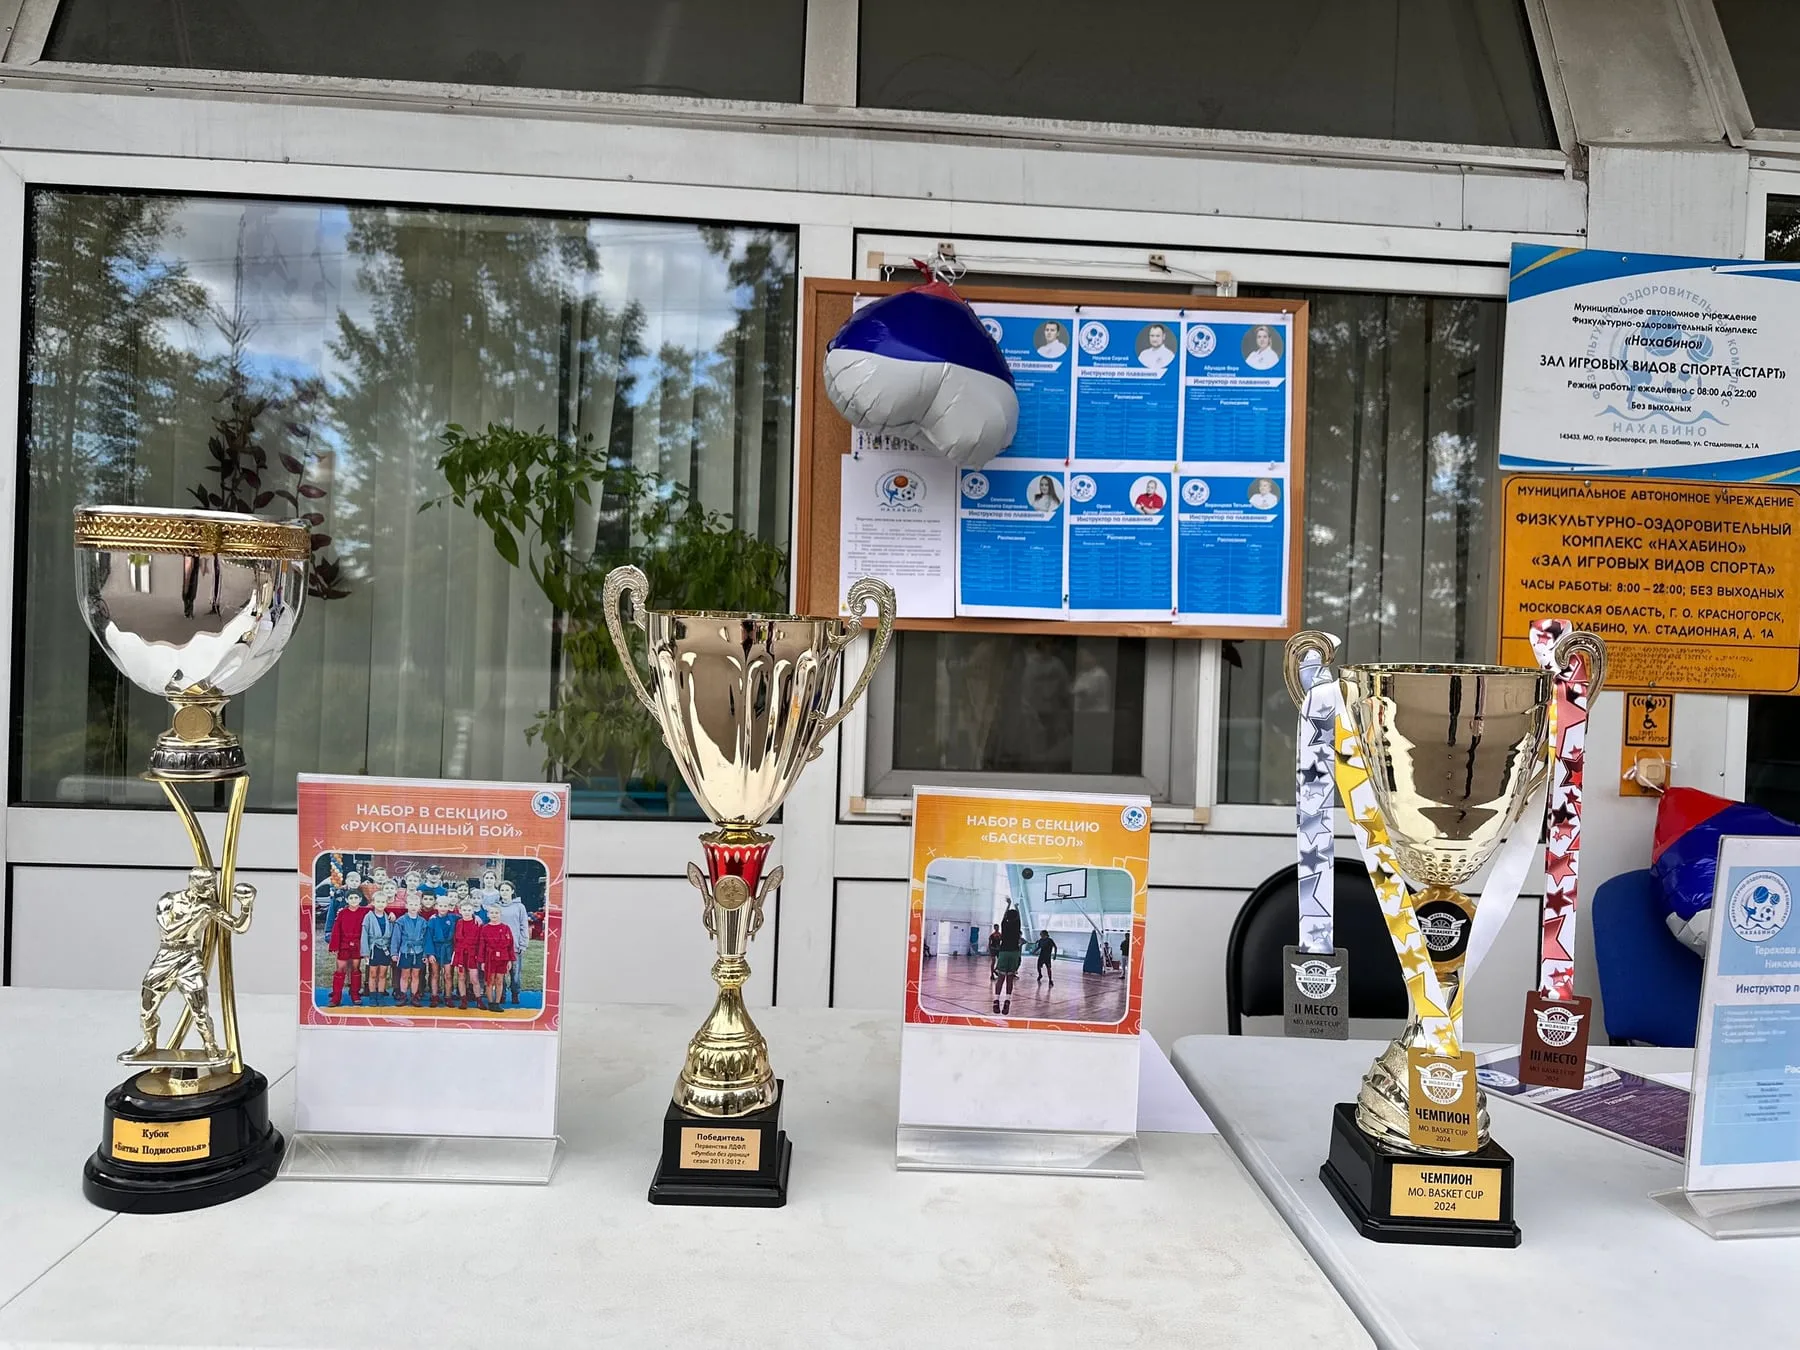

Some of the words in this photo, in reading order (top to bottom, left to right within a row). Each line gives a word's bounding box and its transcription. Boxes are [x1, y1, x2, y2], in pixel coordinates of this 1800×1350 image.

[1573, 303, 1644, 315] Муниципальное
[1646, 308, 1699, 318] автономное
[1702, 312, 1757, 321] учреждение
[1572, 316, 1713, 332] Физкультурно-оздоровительный
[1715, 326, 1757, 335] комплекс
[1625, 335, 1702, 349] «Нахабино»
[1540, 355, 1565, 367] ЗАЛ
[1569, 357, 1628, 371] ИГРОВЫХ
[1632, 361, 1676, 374] ВИДОВ
[1680, 364, 1731, 376] СПОРТА
[1736, 367, 1786, 379] «СТАРТ»
[1567, 380, 1597, 389] Режим
[1599, 383, 1635, 392] работы:
[1637, 385, 1687, 395] ежедневно
[1697, 388, 1719, 396] 08:00
[1721, 390, 1732, 398] до
[1735, 390, 1757, 398] 22:00
[1631, 402, 1645, 410] Без
[1648, 404, 1691, 412] выходных
[1613, 422, 1707, 436] НАХАБИНО
[1518, 486, 1626, 499] МУНИЦИПАЛЬНОЕ
[1631, 490, 1710, 503] АВТОНОМНОЕ
[1714, 495, 1794, 508] УЧРЕЖДЕНИЕ
[1516, 513, 1792, 536] ФИЗКУЛЬТУРНО-ОЗДОРОВИТЕЛЬНЫЙ
[1562, 535, 1642, 549] КОМПЛЕКС
[1649, 539, 1746, 553] «НАХАБИНО»
[1532, 554, 1572, 567] «ЗАЛ
[1577, 556, 1649, 570] ИГРОВЫХ
[1655, 559, 1704, 574] ВИДОВ
[1710, 561, 1775, 575] СПОРТА»
[1520, 579, 1554, 590] ЧАСЫ
[1559, 580, 1612, 592] РАБОТЫ:
[1617, 583, 1640, 593] 8:00
[1690, 586, 1712, 596] БЕЗ
[1717, 587, 1784, 599] ВЫХОДНЫХ
[1520, 603, 1602, 614] МОСКОВСКАЯ
[1606, 605, 1665, 619] ОБЛАСТЬ,
[1670, 608, 1678, 618] Г.
[1682, 608, 1693, 618] О.
[1698, 609, 1784, 623] КРАСНОГОРСК,
[1571, 622, 1627, 635] ХАБИНО,
[1633, 624, 1650, 634] УЛ.
[1656, 625, 1739, 639] СТАДИОННАЯ,
[1743, 628, 1755, 639] Д.
[1761, 629, 1774, 639] 1А
[356, 804, 414, 818] НАБОР
[420, 806, 430, 817] В
[434, 807, 508, 821] СЕКЦИЮ
[340, 821, 474, 836] «РУКОПАШНЫЙ
[479, 823, 523, 837] БОЙ»
[967, 815, 1018, 828] НАБОР
[1022, 818, 1031, 829] В
[1035, 819, 1100, 833] СЕКЦИЮ
[981, 832, 1083, 848] «БАСКЕТБОЛ»
[1736, 984, 1791, 995] Инструктор
[1793, 984, 1800, 992] п
[1295, 1004, 1301, 1014] II
[1304, 1004, 1338, 1016] МЕСТО
[1530, 1050, 1540, 1061] III
[1543, 1051, 1578, 1065] МЕСТО
[1415, 1108, 1470, 1125] ЧЕМПИОН
[142, 1129, 170, 1139] Кубок
[697, 1133, 745, 1142] Победитель
[1431, 1126, 1455, 1135] BASKET
[1436, 1135, 1451, 1143] 2024
[142, 1144, 206, 1156] Подмосковья»
[1420, 1172, 1472, 1185] ЧЕМПИОН
[1408, 1187, 1426, 1197] MO.
[1429, 1188, 1463, 1199] BASKET
[1465, 1190, 1484, 1200] CUP
[1434, 1202, 1456, 1211] 2024
